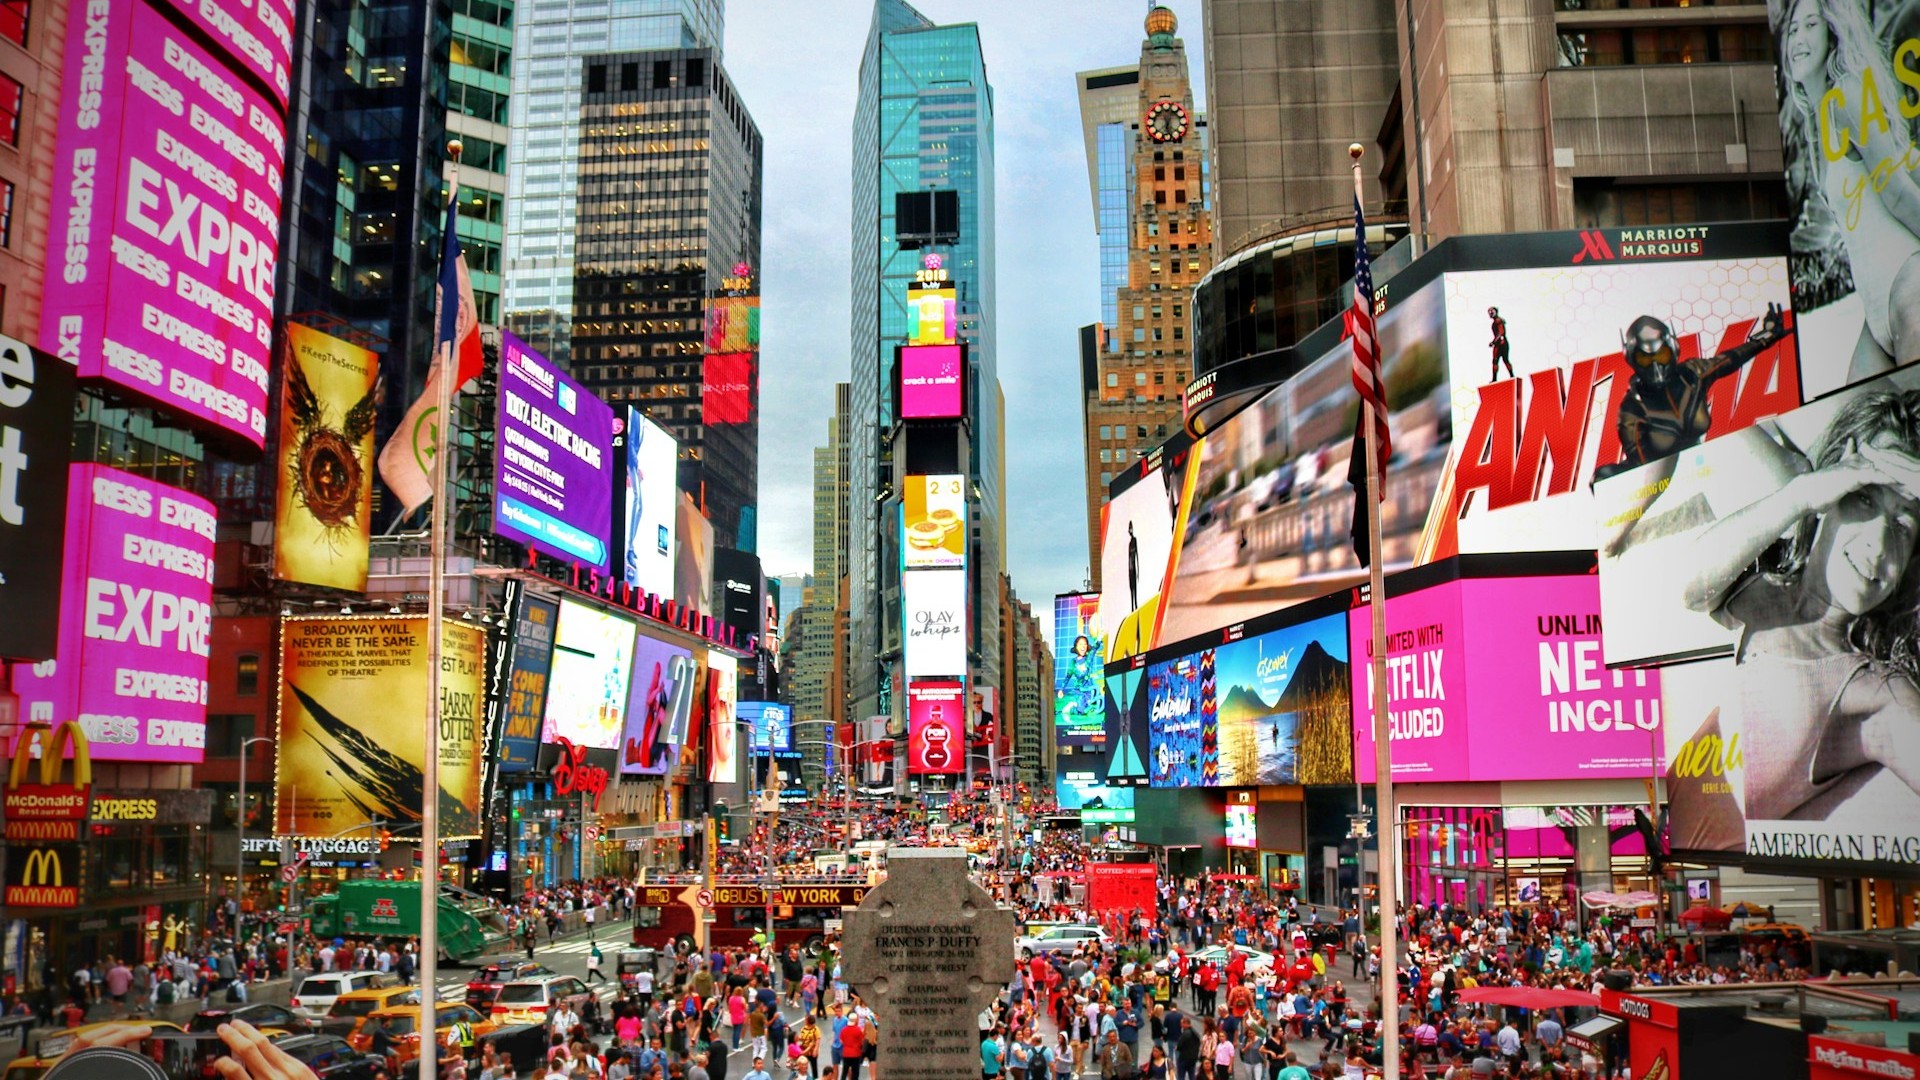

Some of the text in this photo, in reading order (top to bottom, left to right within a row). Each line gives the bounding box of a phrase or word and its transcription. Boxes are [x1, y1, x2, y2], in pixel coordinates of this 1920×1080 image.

[163, 37, 245, 118] EXPRESS
[190, 103, 265, 176] EXPRESS
[156, 129, 238, 202] EXPRESS
[63, 148, 97, 284] EXPRESS
[1621, 227, 1709, 242] MARRIOTT
[1622, 241, 1700, 257] MARQUIS
[176, 271, 254, 333] EXPRESS
[142, 303, 226, 365] EXPRESS
[300, 345, 369, 377] #KeepTheSecrets
[1187, 372, 1217, 396] MARRIOTT
[170, 368, 248, 424] EXPRESS
[1188, 386, 1214, 408] MARQUIS
[1148, 446, 1164, 463] MARRIOTT
[930, 481, 961, 494] 2 3
[123, 533, 205, 579] EXPRESS
[571, 564, 737, 647] 1540 BROADWAY
[915, 610, 955, 623] OLAY
[380, 623, 411, 634] WILL
[910, 619, 961, 640] whips
[1417, 624, 1444, 645] WITH
[292, 636, 419, 648] NEVER BE THE SAME.
[356, 649, 388, 657] MARVEL
[358, 659, 411, 667] POSSIBILITIES
[440, 656, 477, 676] EST PLAY
[115, 668, 199, 706] EXPRESS
[505, 714, 539, 738] AWAY
[6, 795, 84, 807] McDonald's
[91, 799, 158, 820] EXPRESS
[18, 808, 70, 816] Restaurant
[241, 839, 381, 854] GIFTS LUGGAGE
[1749, 833, 1920, 864] AMERICAN EAG
[762, 889, 797, 903] NW
[800, 889, 840, 903] YORK
[882, 925, 972, 934] LIEUTENANT COLONEL
[876, 936, 981, 947] FRANCIS DUFFY
[889, 964, 967, 972] CATHOLIC PRIEST
[930, 1046, 970, 1054] COUNTRY
[1815, 1046, 1915, 1080] belgian waffles
